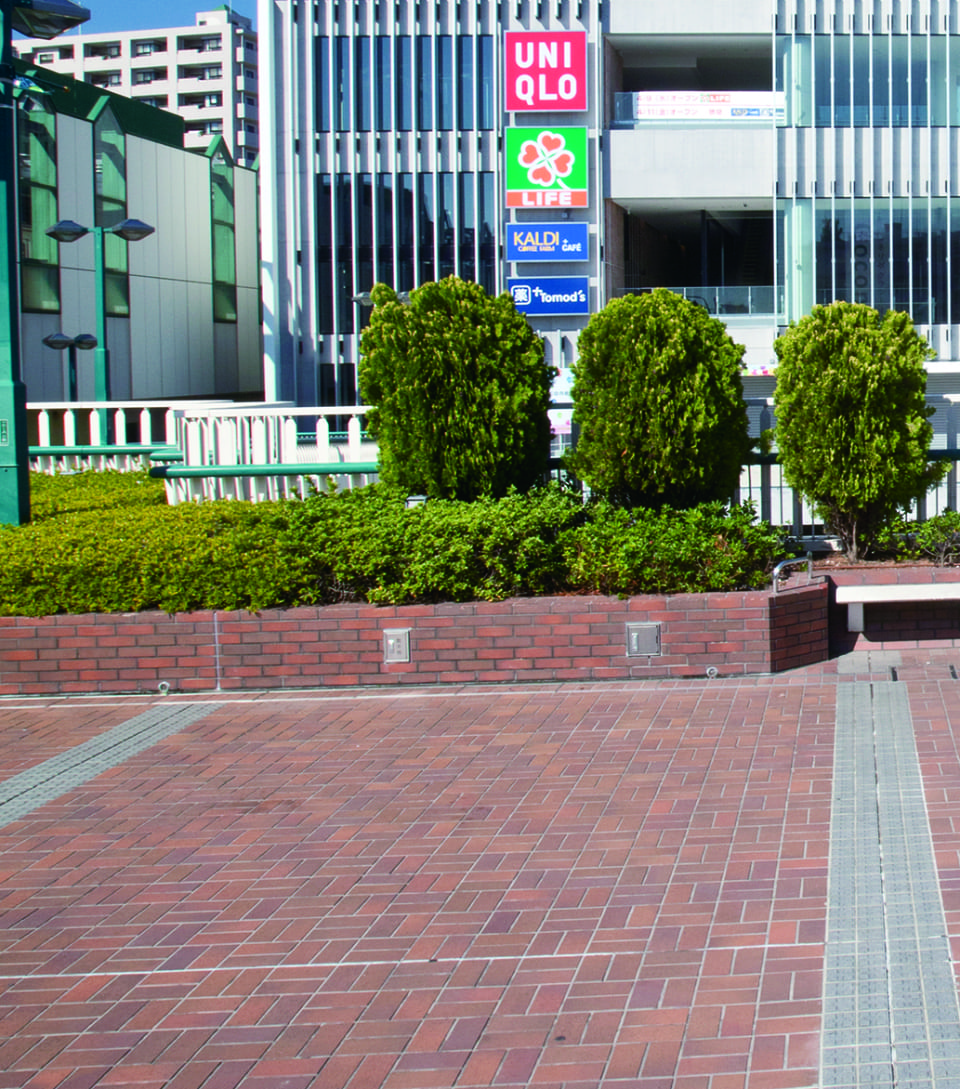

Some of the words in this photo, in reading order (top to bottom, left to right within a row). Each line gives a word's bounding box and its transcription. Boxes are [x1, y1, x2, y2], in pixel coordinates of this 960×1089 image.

[515, 42, 571, 68] UNI
[515, 74, 577, 105] QLO
[522, 191, 572, 206] LIFE
[513, 231, 560, 246] KALDI
[540, 290, 586, 303] Tomod's
